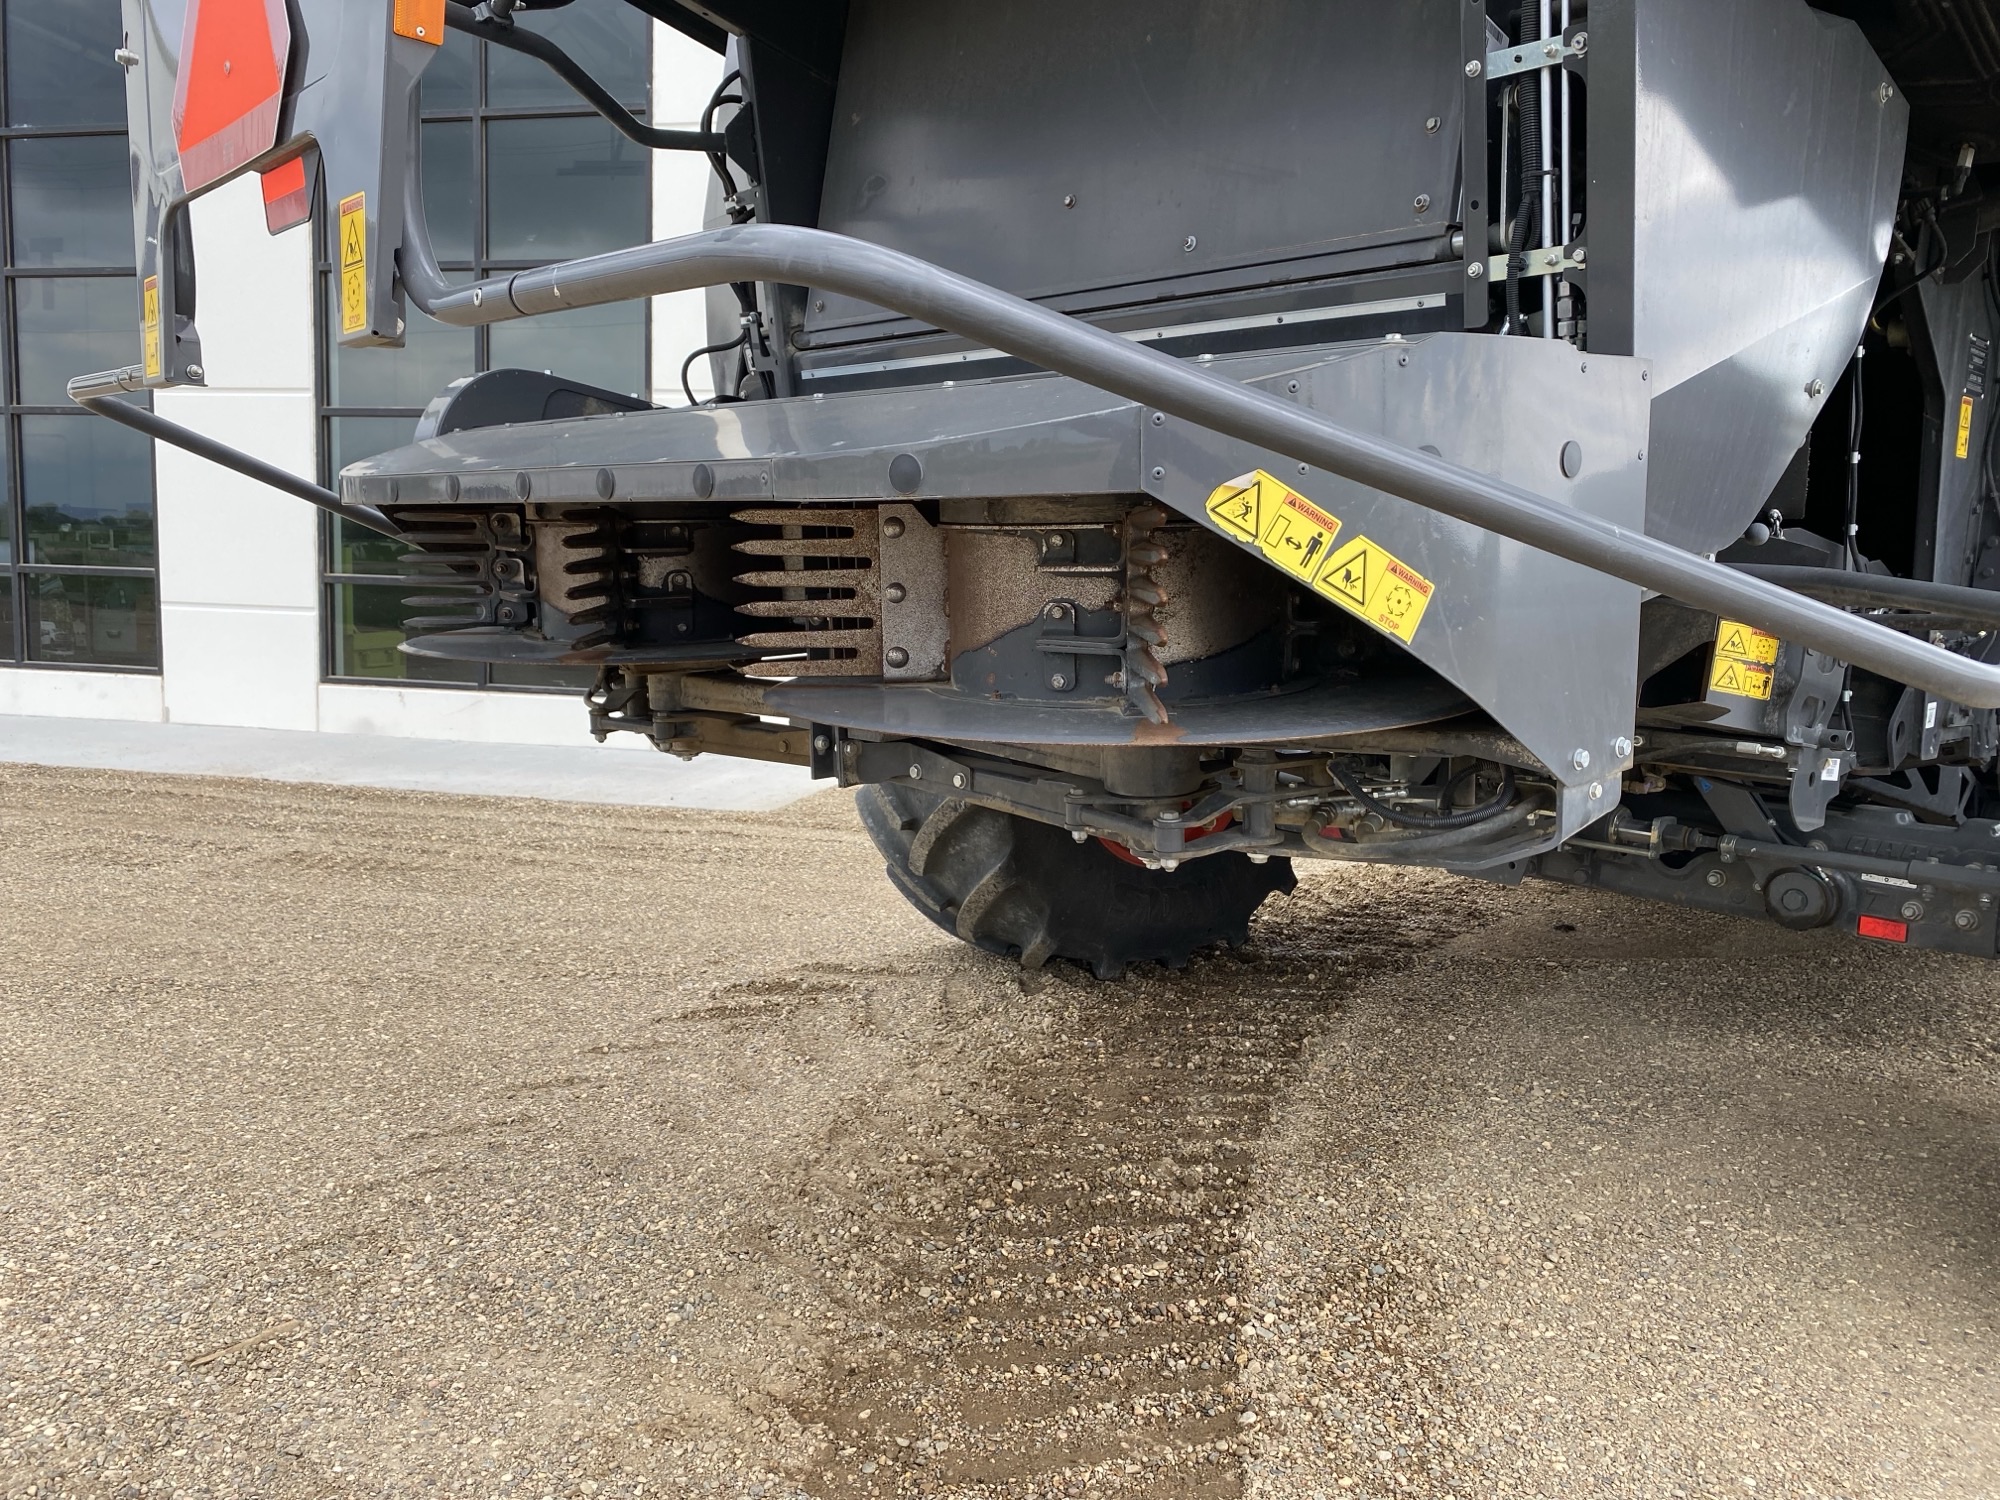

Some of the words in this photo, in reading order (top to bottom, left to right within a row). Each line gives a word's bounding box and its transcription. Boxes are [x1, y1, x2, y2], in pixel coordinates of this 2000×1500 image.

[1297, 501, 1333, 531] WARNING
[1398, 568, 1428, 594] WARNING
[1378, 613, 1400, 631] STOP
